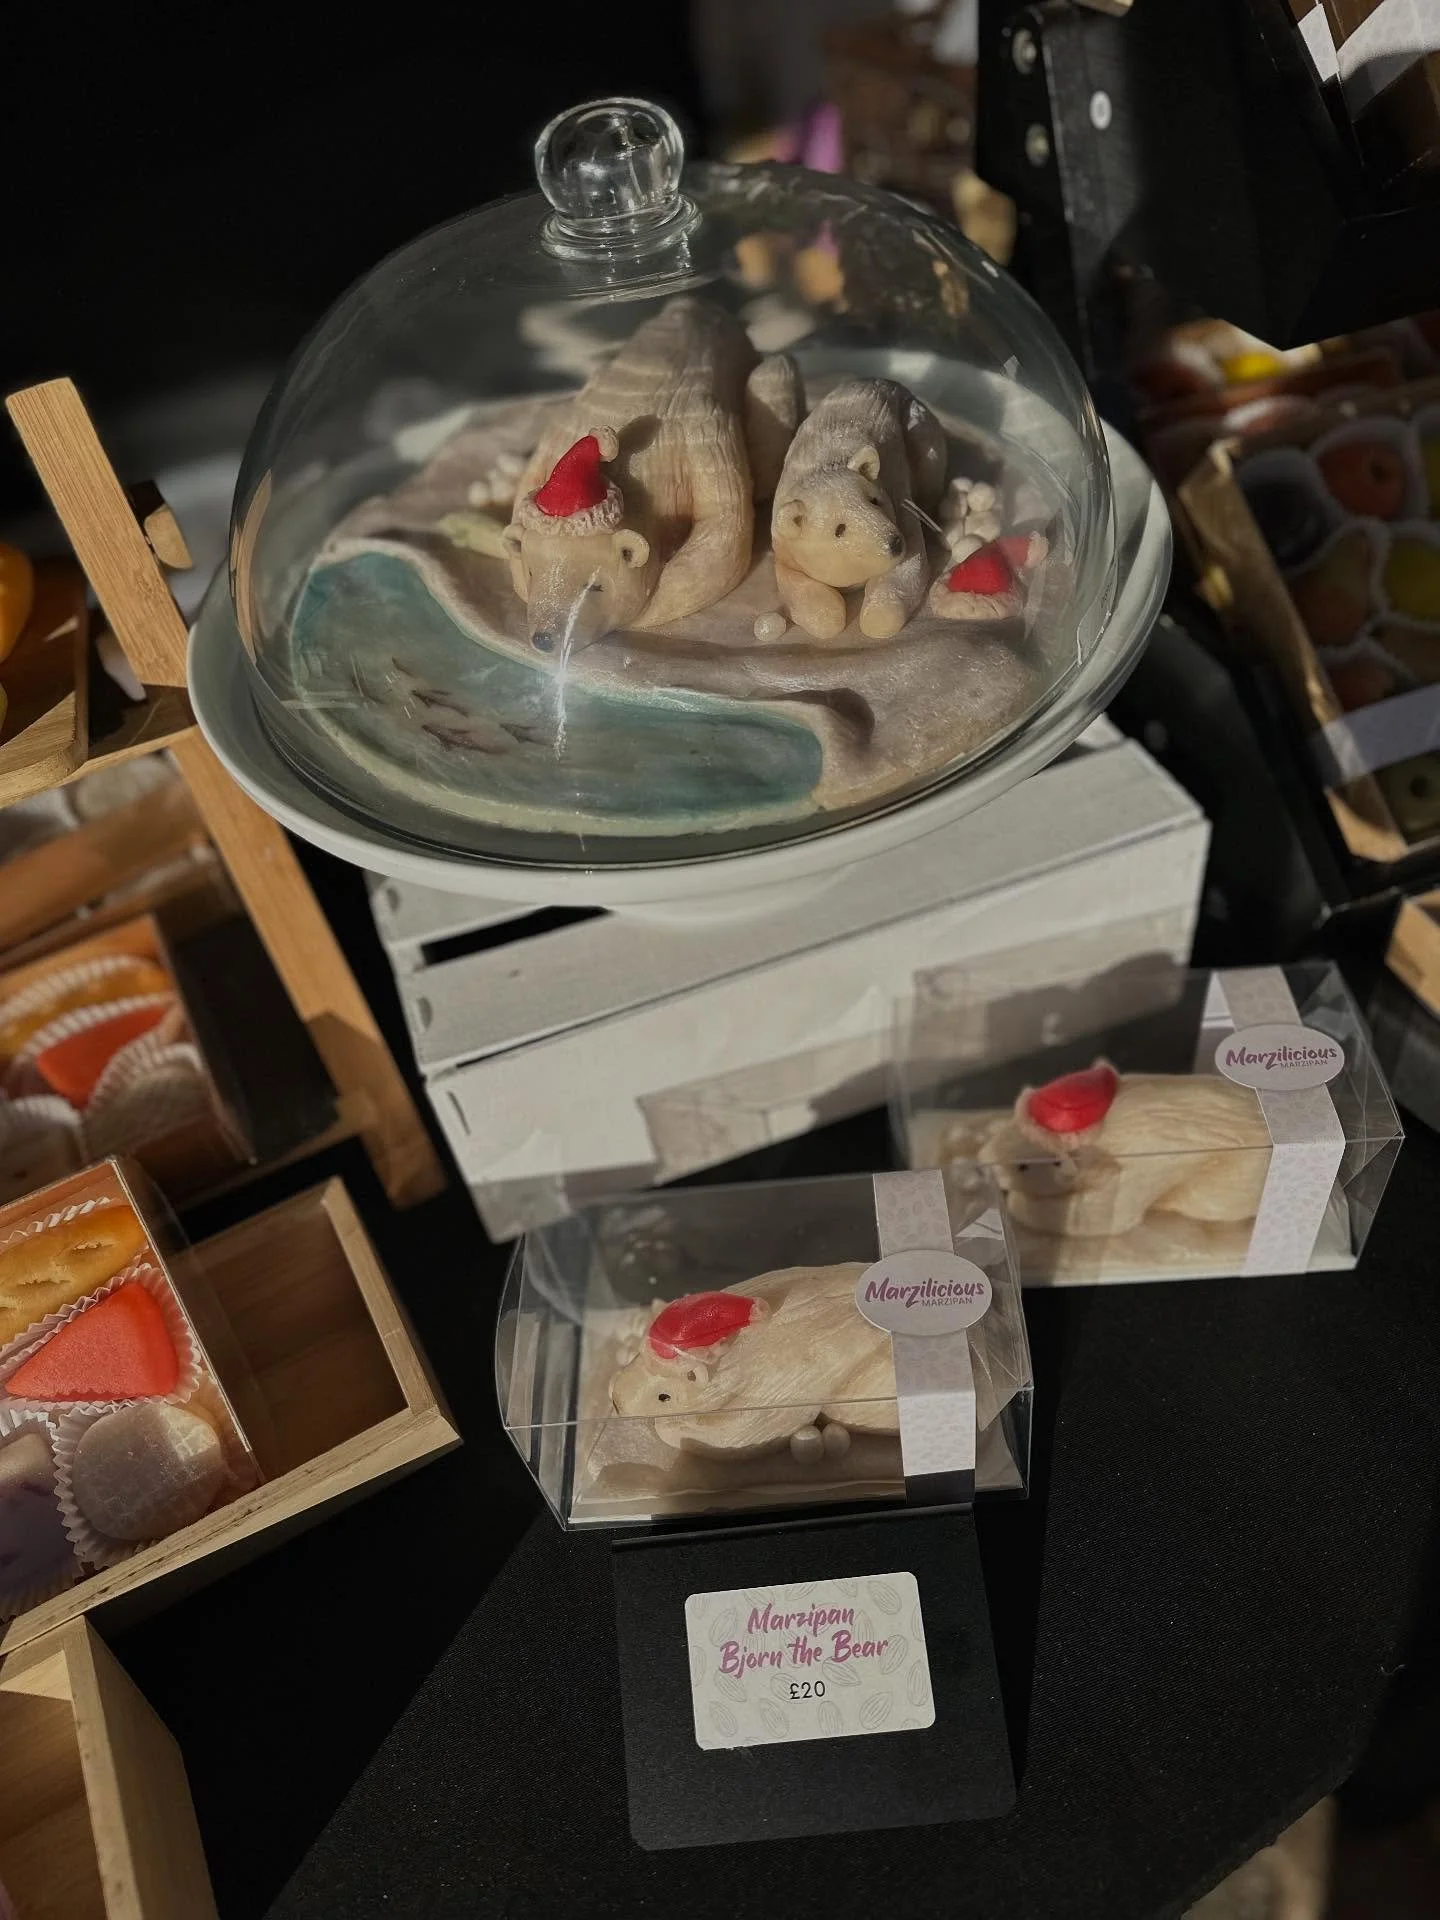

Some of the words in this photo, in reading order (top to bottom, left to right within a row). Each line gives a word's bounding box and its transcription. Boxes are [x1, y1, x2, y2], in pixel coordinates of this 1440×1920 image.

[1225, 1045, 1338, 1070] Marzilicious
[1280, 1059, 1328, 1069] MARZIPAN
[864, 1276, 985, 1309] Marzilicious
[921, 1296, 973, 1308] MARZIPAN
[747, 1602, 855, 1637] Marzipan
[719, 1640, 783, 1680] Bjorn
[787, 1635, 823, 1667] the
[830, 1629, 889, 1664] Bear
[789, 1680, 826, 1700] £20
